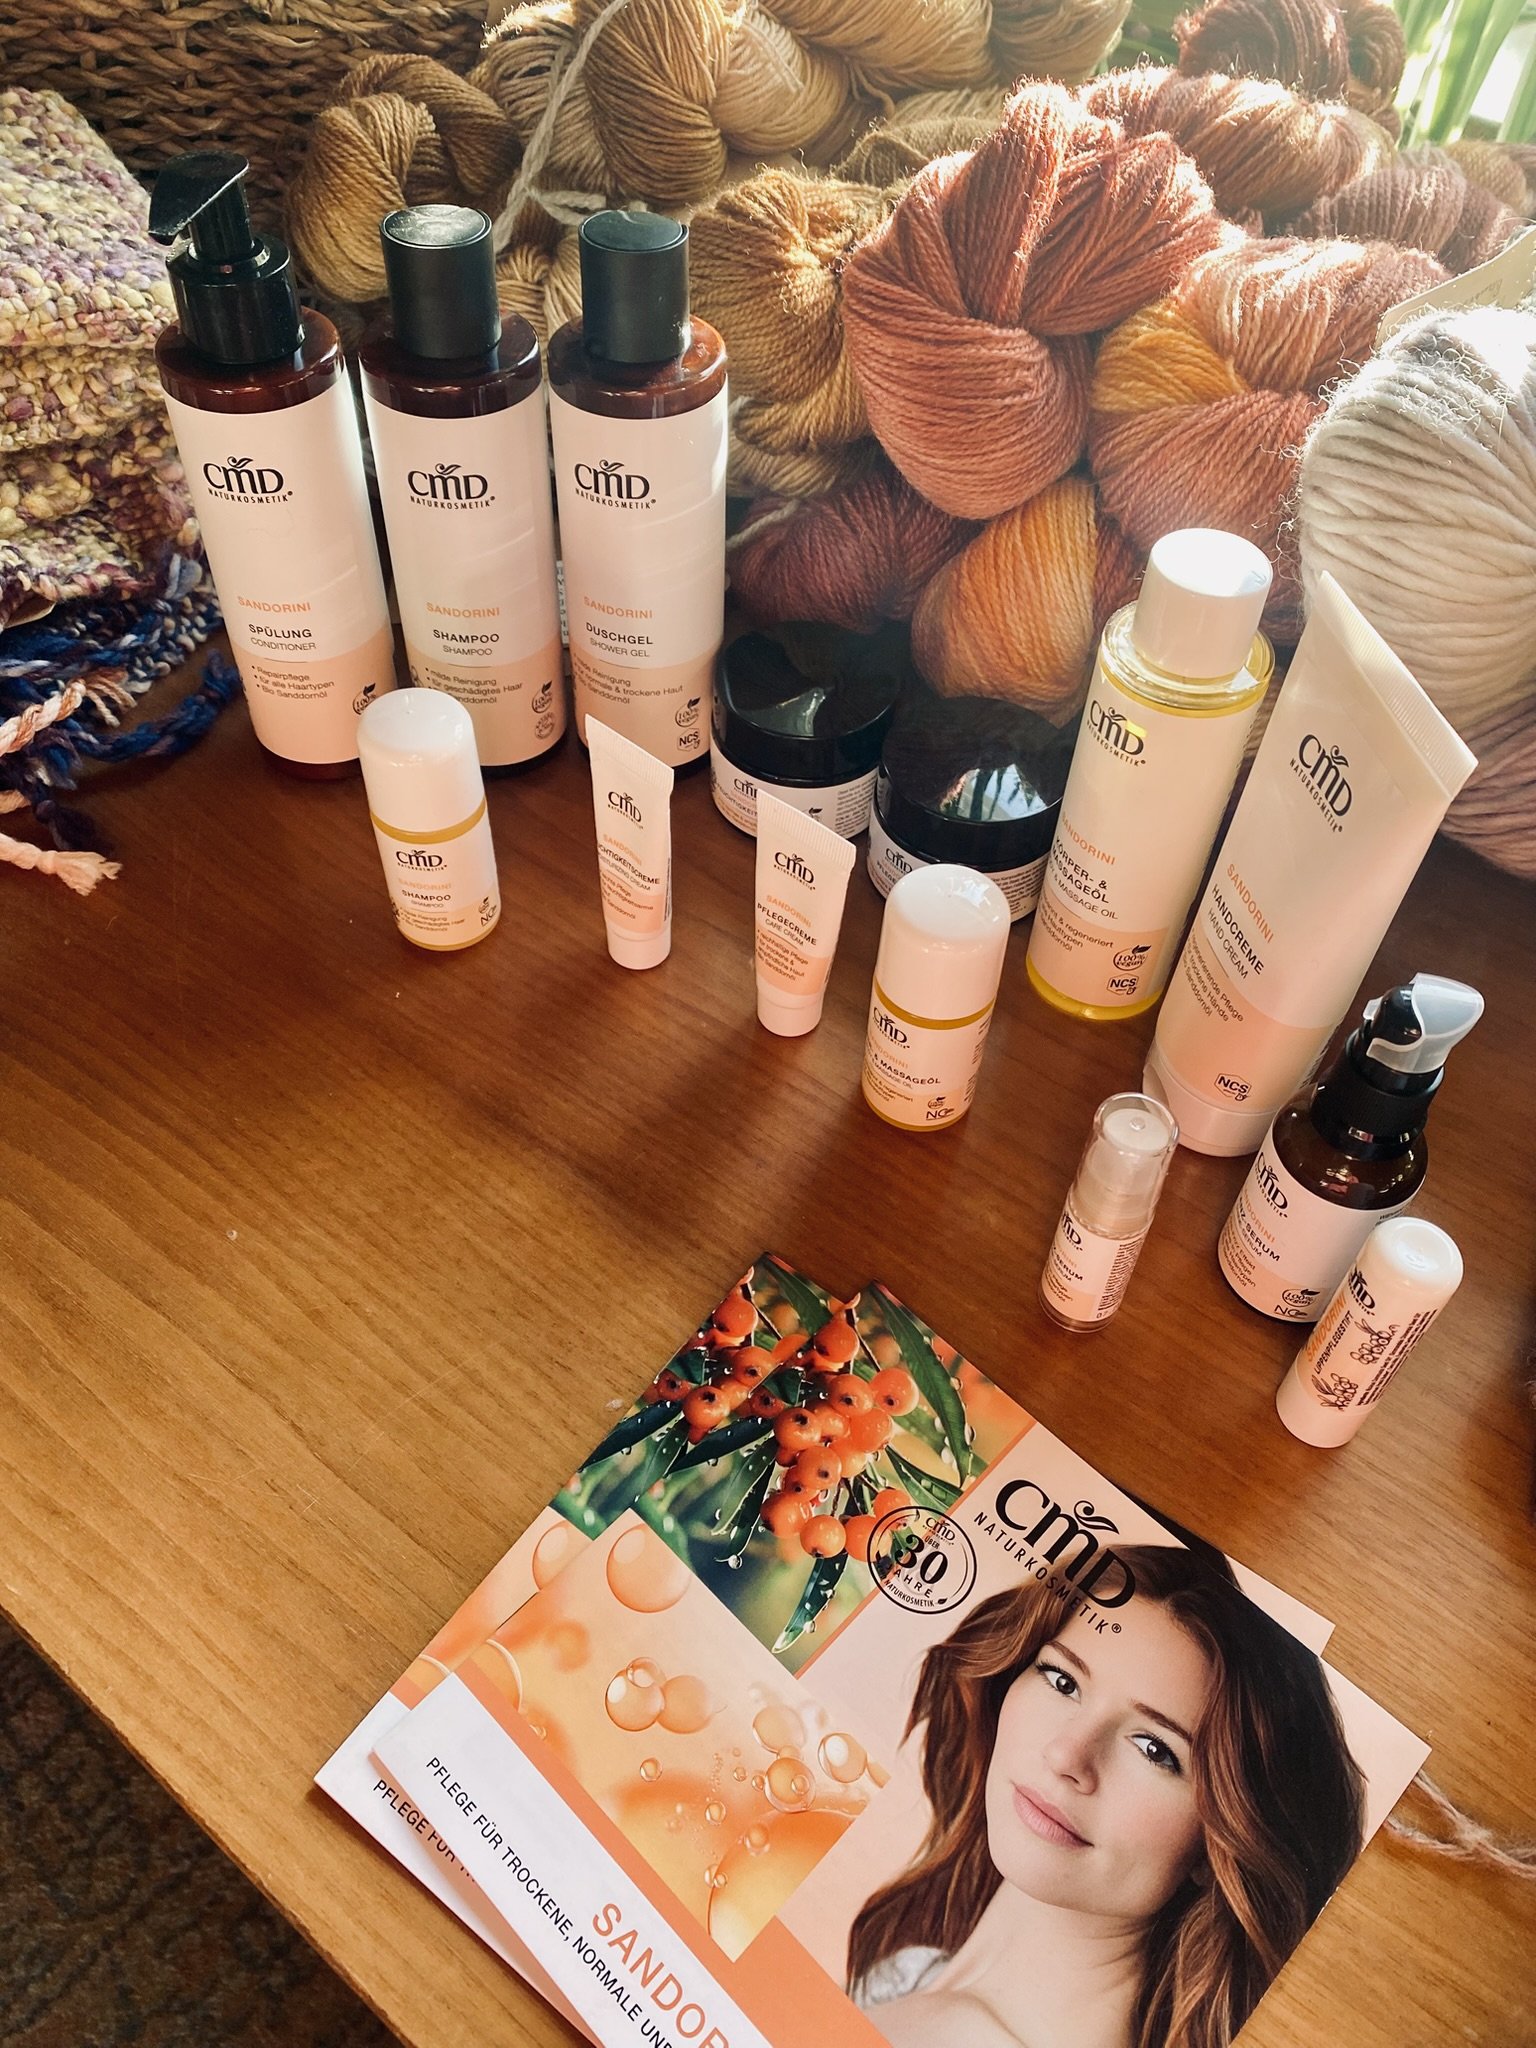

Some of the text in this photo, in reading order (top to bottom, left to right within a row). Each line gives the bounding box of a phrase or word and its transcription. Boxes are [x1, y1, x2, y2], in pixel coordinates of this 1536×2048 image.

[237, 595, 311, 613] SANDORINI
[426, 601, 500, 618] SANDORINI
[584, 597, 653, 619] SANDORINI
[248, 623, 312, 639] SPÜLUNG
[433, 629, 500, 644] SHAMPOO
[586, 622, 654, 645] DUSCHGEL
[250, 637, 317, 651] CONDITIONER
[443, 645, 493, 656] SHAMPOO
[589, 637, 650, 658] SHOWER GEL
[663, 685, 683, 695] Haut
[1098, 879, 1108, 889] &
[402, 889, 451, 901] SHAMPOO
[1227, 863, 1274, 944] SANDORINI
[757, 902, 817, 946] PFLEGECREME
[1100, 908, 1118, 920] OIL
[1211, 884, 1265, 975] HANDCREME
[1208, 909, 1249, 980] HAND CREAM
[1110, 978, 1136, 988] NCS
[880, 1059, 941, 1085] MASSAGEÖL
[1217, 1075, 1250, 1093] NCS
[1307, 1290, 1347, 1362] SANDORINI
[1314, 1310, 1354, 1374] LIPPENPFLEGESTIFT
[894, 1534, 948, 1585] 30
[884, 1579, 935, 1607] NATURKOSMETIK
[373, 1779, 430, 1834] PFLEGE
[426, 1756, 478, 1818] PFLEGE
[473, 1813, 504, 1852] FÜR
[503, 1846, 574, 1942] TROCKENE,
[572, 1935, 643, 2022] NORMALE
